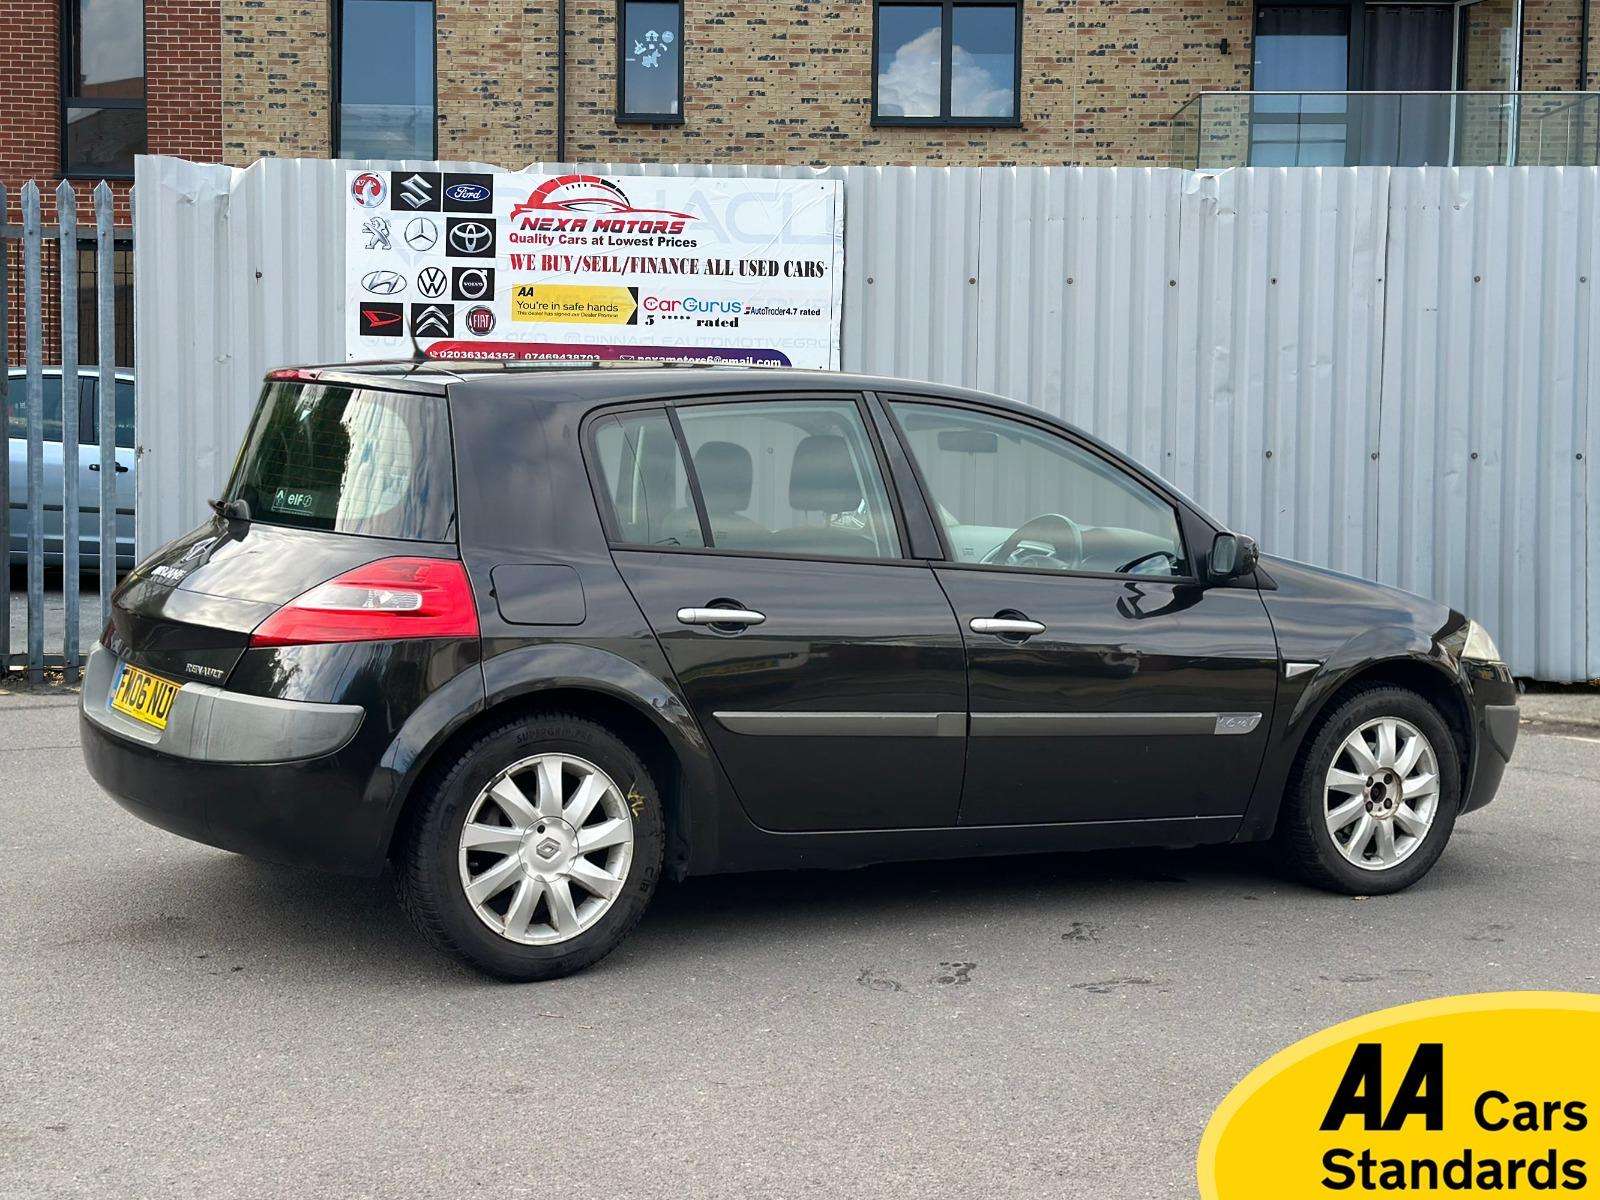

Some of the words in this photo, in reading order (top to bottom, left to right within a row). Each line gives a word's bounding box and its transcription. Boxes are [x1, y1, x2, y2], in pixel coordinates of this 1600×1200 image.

[454, 186, 481, 199] Ford
[520, 217, 588, 232] NEXA
[592, 219, 686, 234] MOTORS
[509, 232, 554, 246] Quality
[558, 234, 587, 245] Cars
[591, 235, 604, 246] at
[608, 236, 653, 247] Lowest
[657, 236, 697, 248] Prices
[509, 253, 536, 271] WE
[703, 258, 734, 276] ALL
[739, 260, 780, 277] USED
[518, 287, 534, 297] AA
[516, 300, 549, 310] You're
[551, 302, 560, 310] in
[563, 302, 585, 311] safe
[587, 303, 619, 312] hands
[643, 296, 742, 313] CarGurus
[800, 308, 821, 316] rated
[473, 314, 490, 328] FIAT
[645, 315, 655, 326] 5
[696, 317, 739, 327] rated
[287, 493, 304, 506] elf
[185, 662, 224, 679] RENAULT
